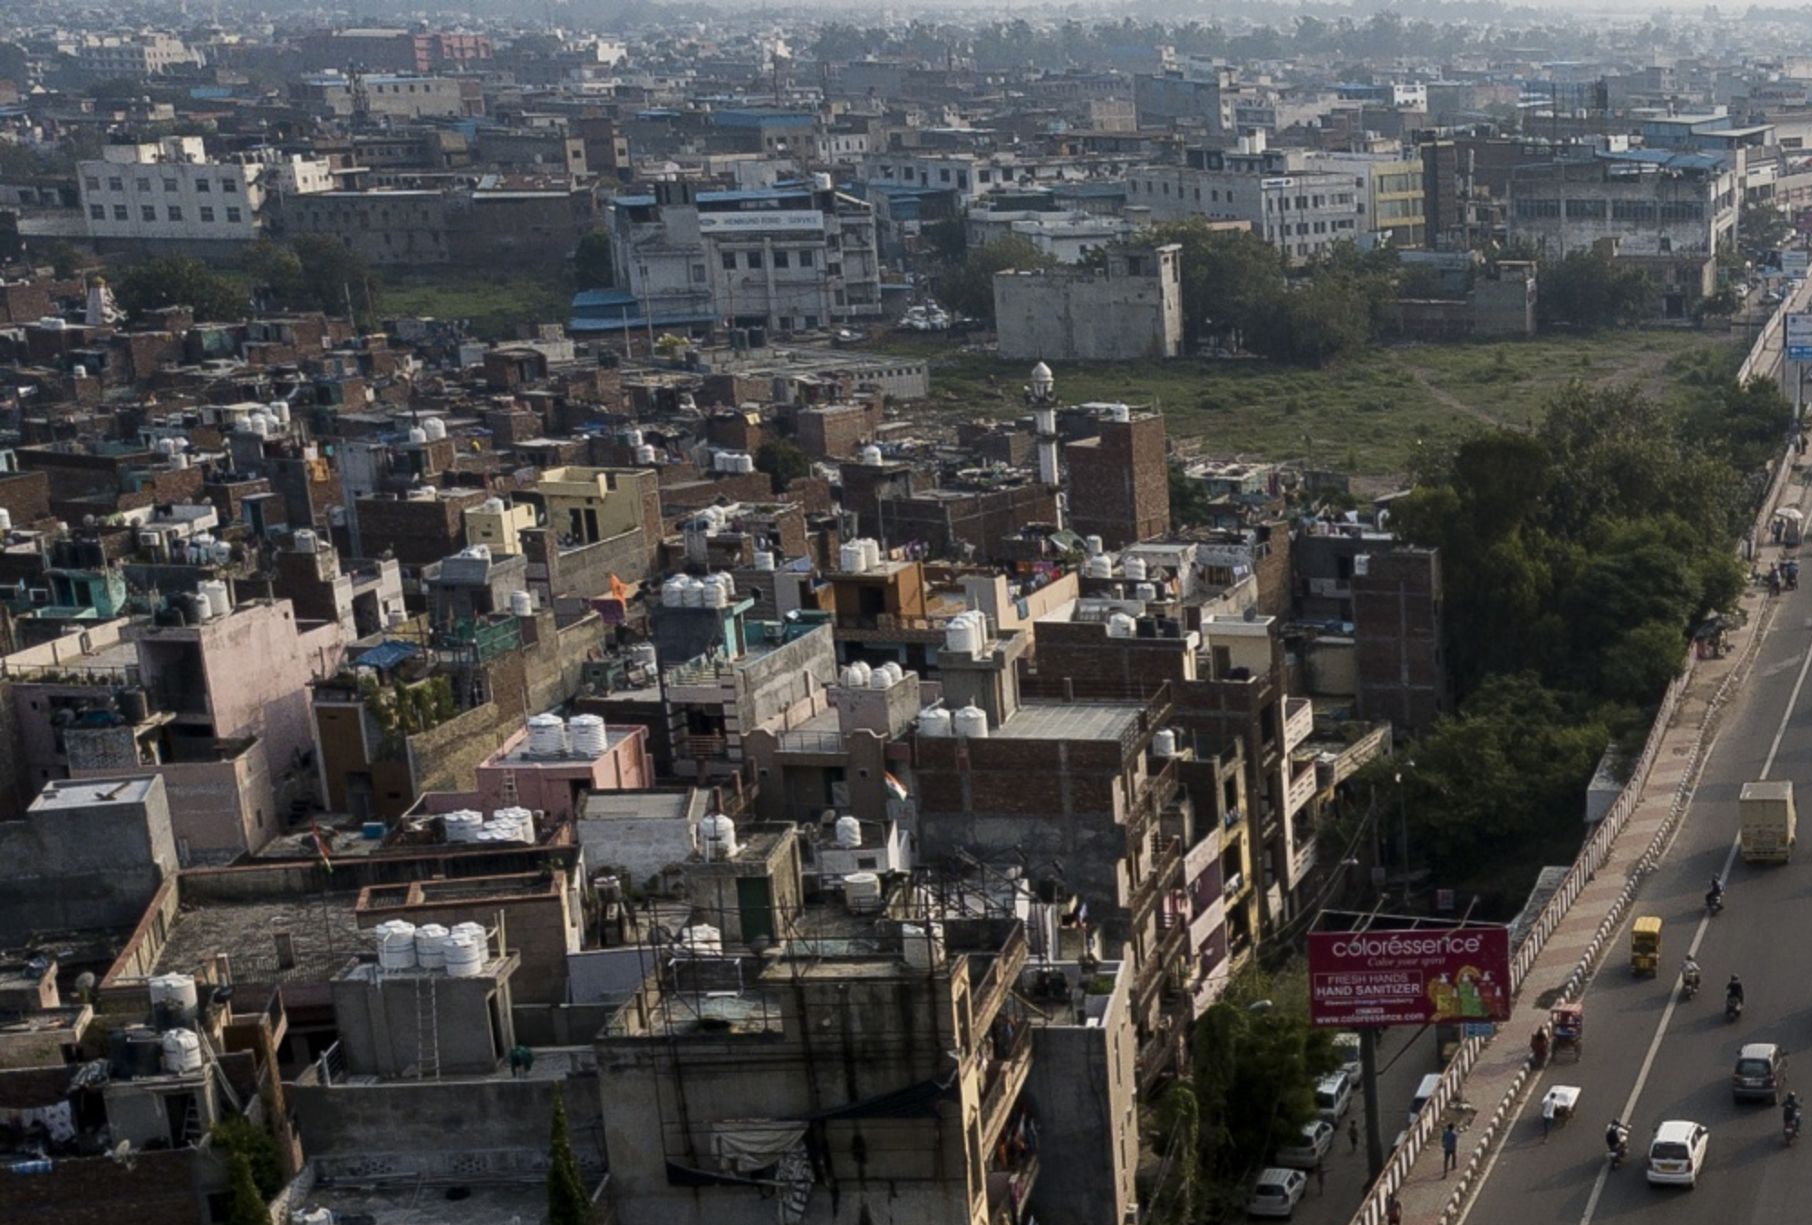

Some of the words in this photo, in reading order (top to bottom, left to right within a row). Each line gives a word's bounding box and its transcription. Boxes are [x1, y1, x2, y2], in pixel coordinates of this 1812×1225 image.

[1328, 975, 1367, 985] FRESH
[1369, 973, 1409, 984] HANDS
[1316, 985, 1353, 997] HAND
[1355, 983, 1421, 996] SANITIZER
